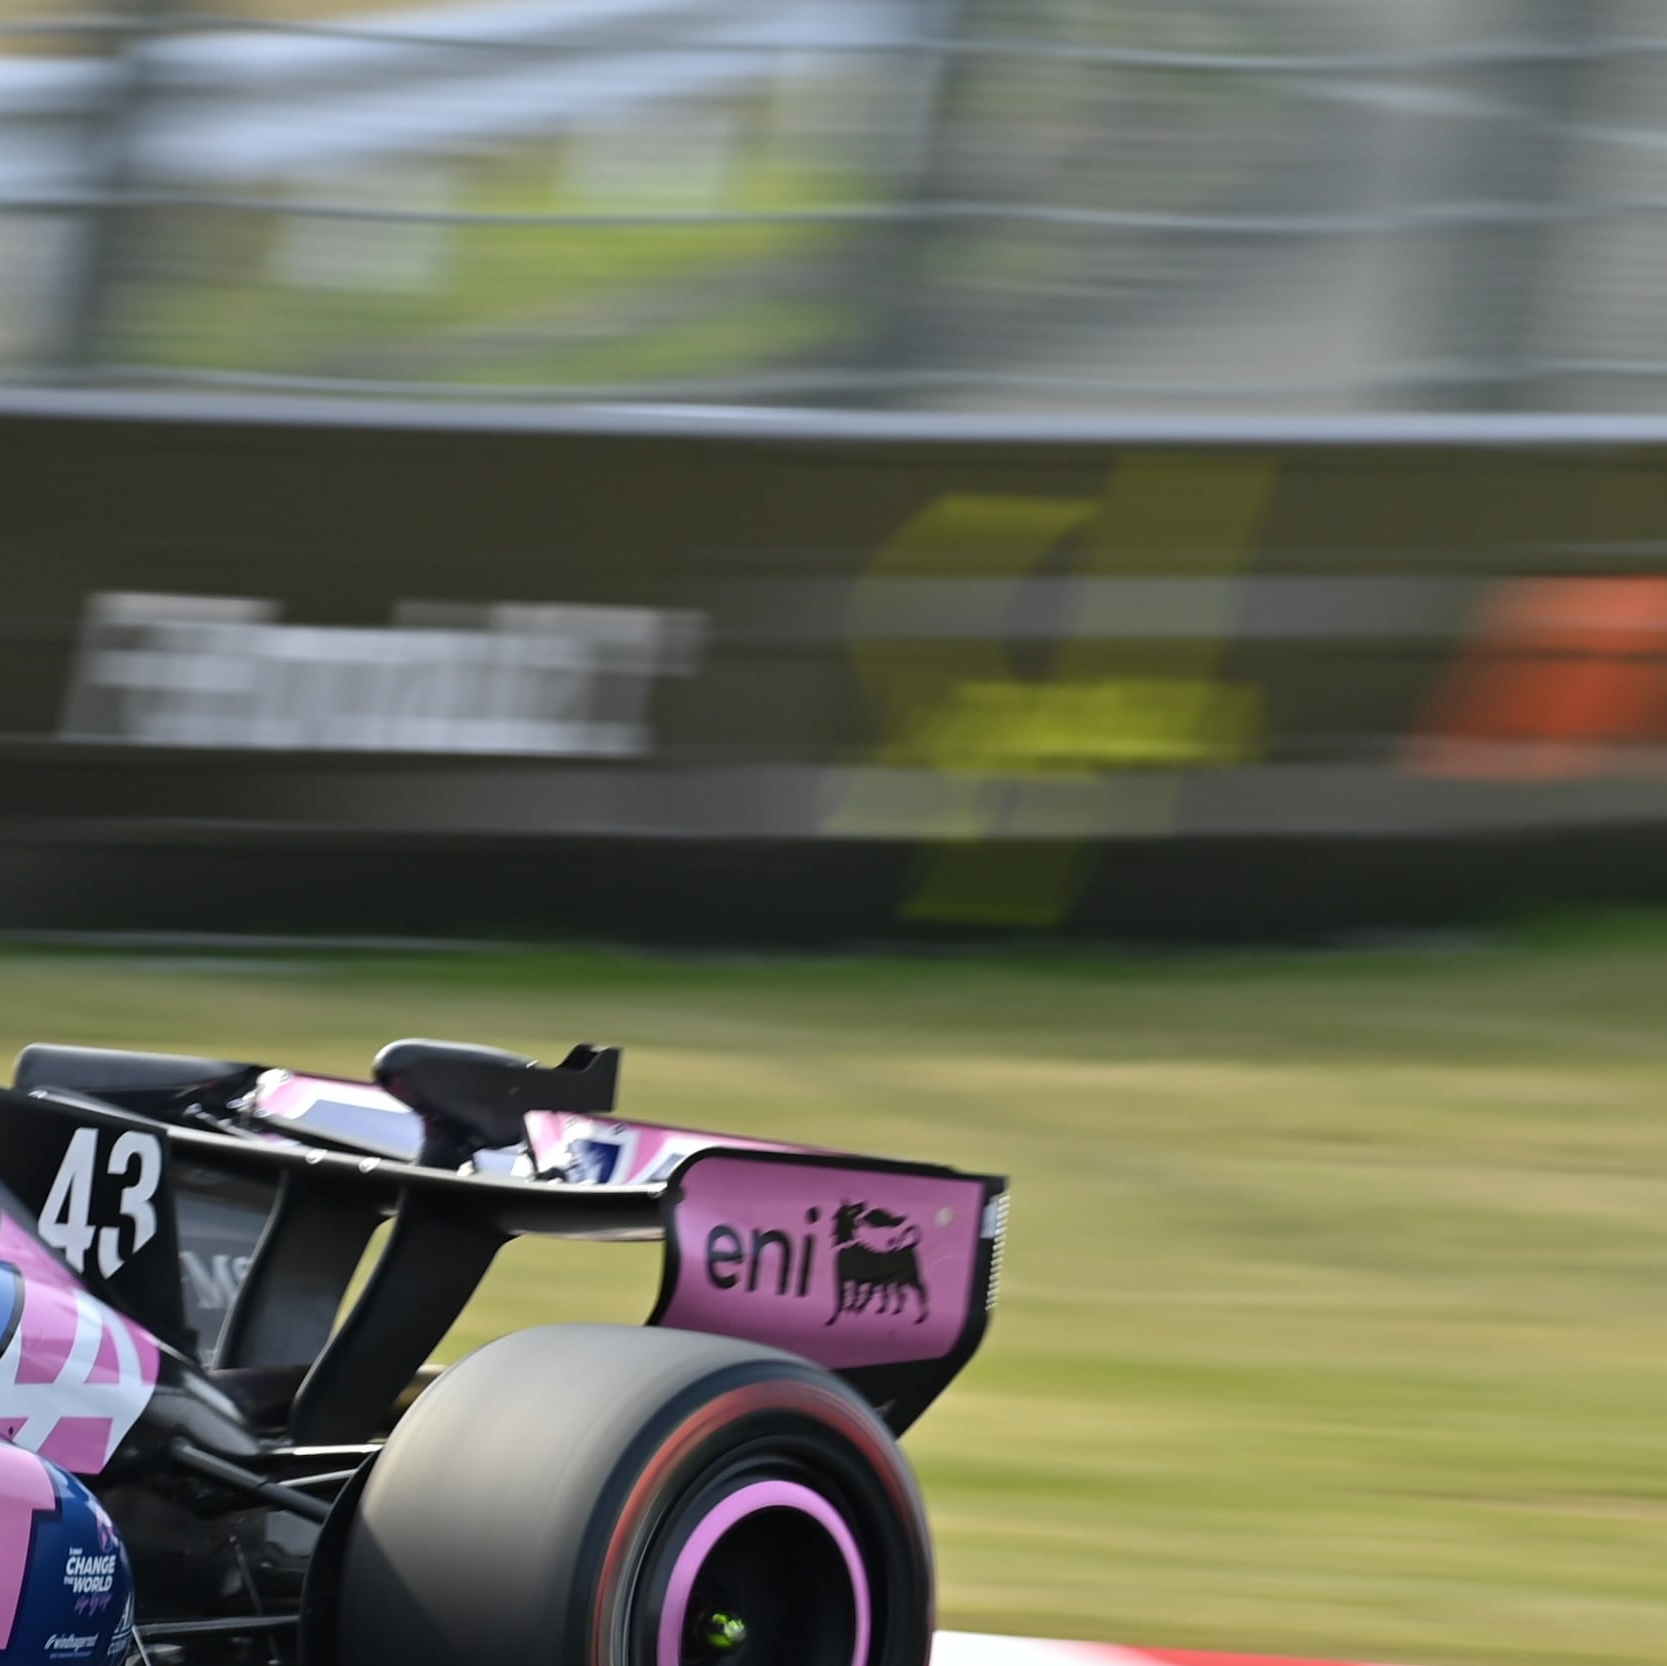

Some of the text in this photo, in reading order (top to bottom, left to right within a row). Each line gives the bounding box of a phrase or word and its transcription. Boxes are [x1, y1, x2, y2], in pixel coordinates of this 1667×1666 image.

[37, 1127, 163, 1280] 43
[706, 1206, 821, 1298] eni
[65, 1555, 117, 1576] CHANGE
[72, 1575, 114, 1593] WORLD
